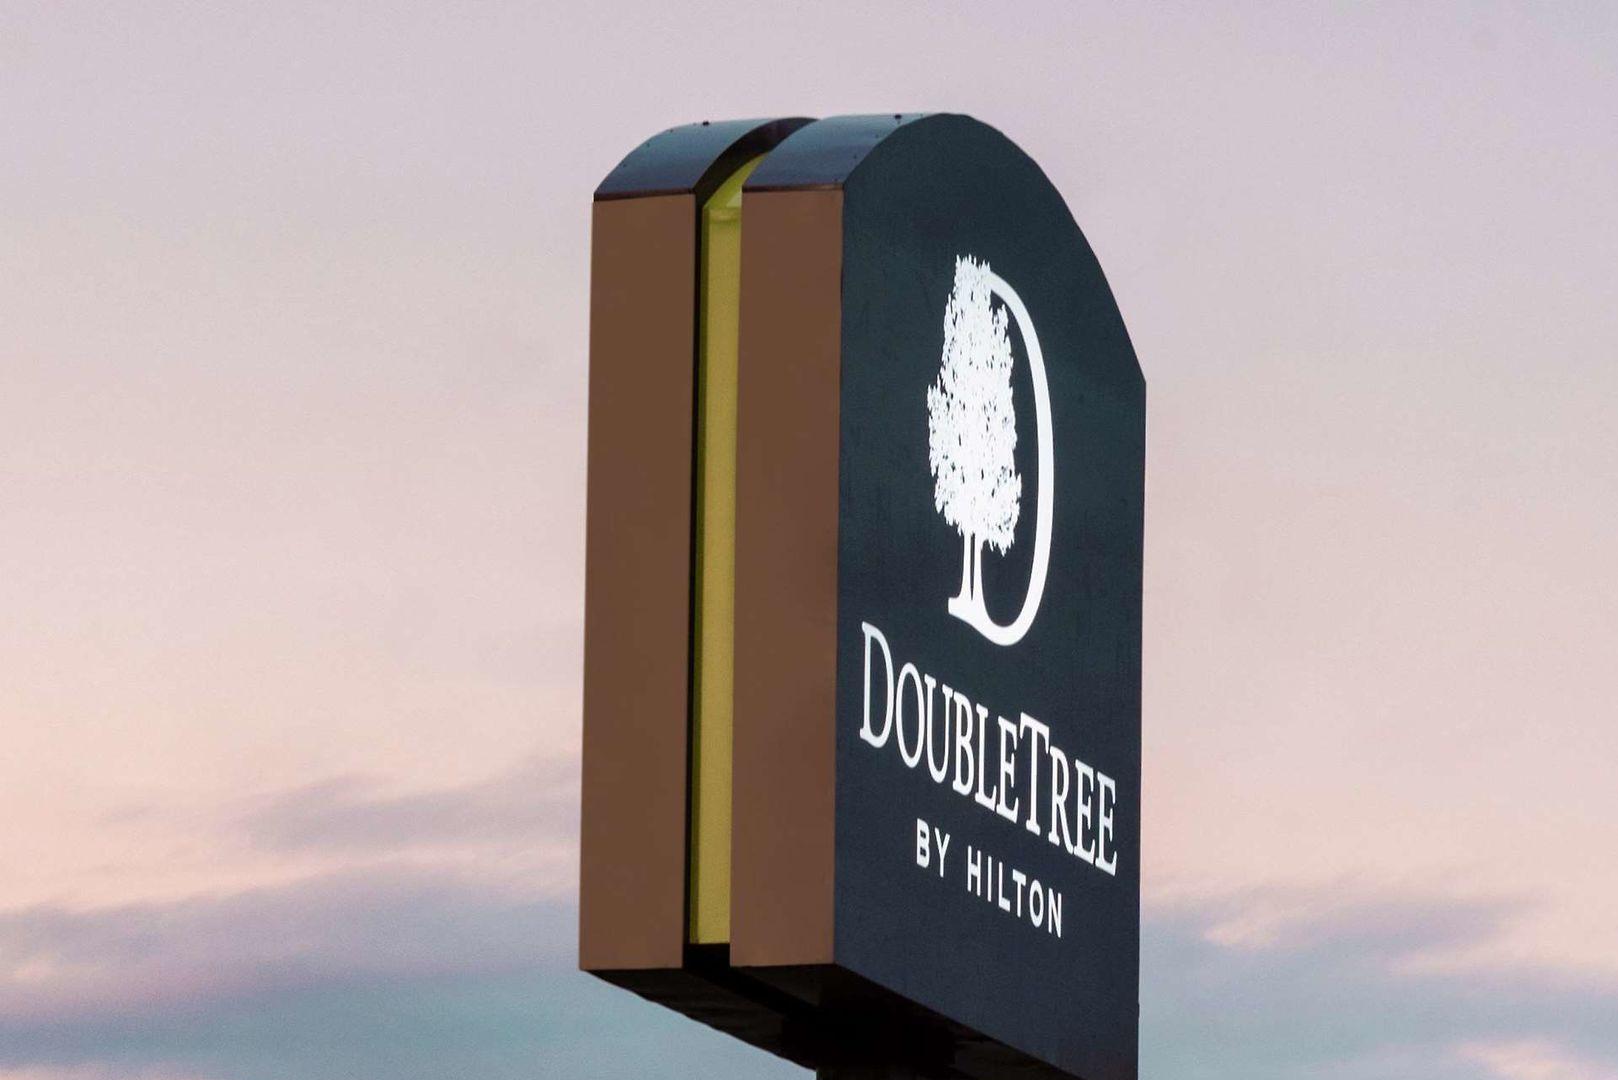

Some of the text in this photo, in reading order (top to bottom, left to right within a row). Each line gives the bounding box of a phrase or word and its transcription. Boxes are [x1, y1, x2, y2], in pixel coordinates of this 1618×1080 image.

[859, 621, 1118, 876] DOUBLETREE
[916, 818, 1062, 938] BY HILTON
